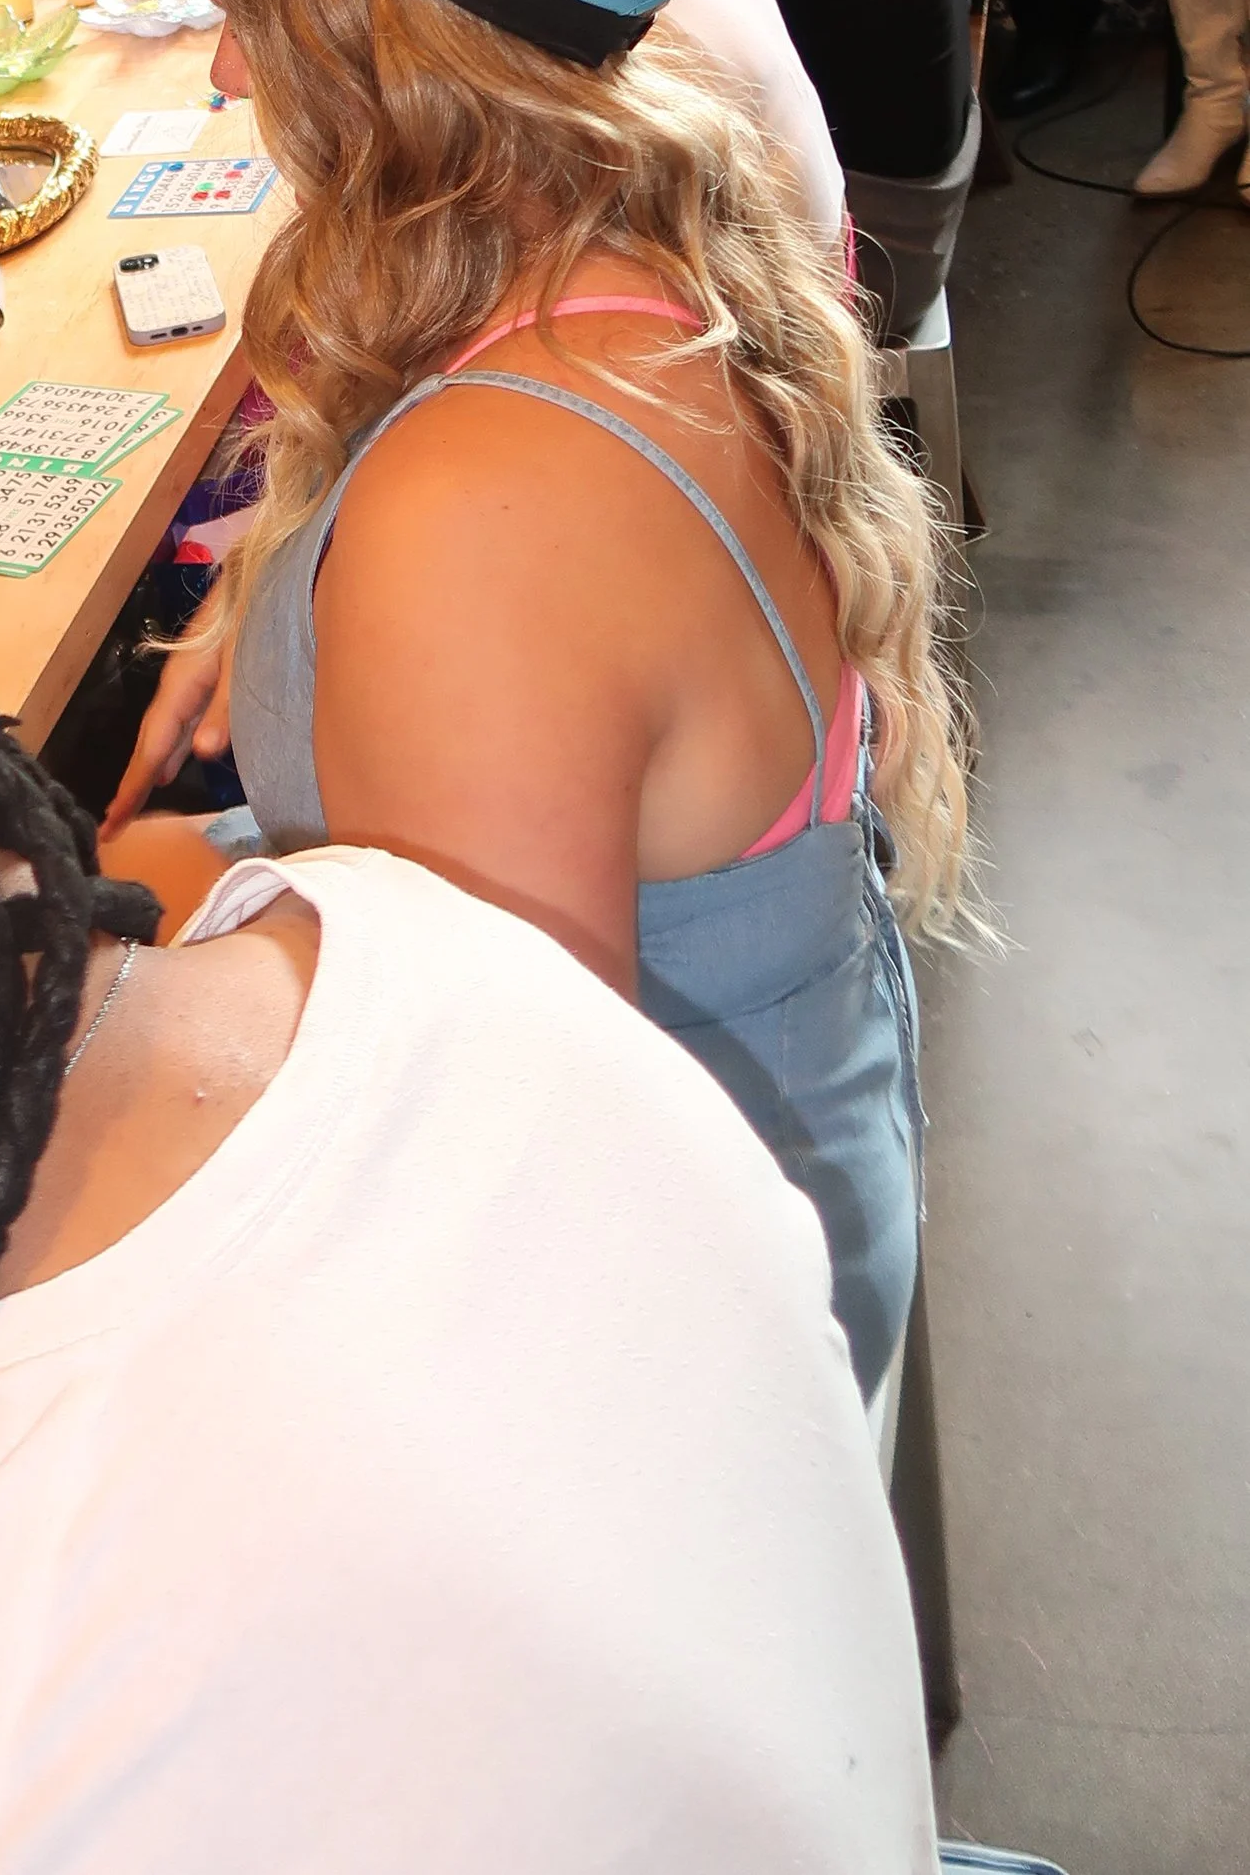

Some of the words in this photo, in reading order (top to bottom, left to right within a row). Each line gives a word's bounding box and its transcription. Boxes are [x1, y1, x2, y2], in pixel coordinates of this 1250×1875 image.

[114, 163, 163, 214] BINGO
[31, 385, 55, 394] 65
[54, 387, 79, 397] 60
[79, 390, 105, 400] 44
[13, 397, 42, 408] 75
[105, 393, 133, 403] 30
[42, 400, 67, 411] 56
[66, 403, 90, 413] 43
[95, 406, 120, 416] 26
[2, 410, 24, 421] 66
[124, 408, 140, 418] 3
[26, 414, 52, 424] 53
[80, 418, 103, 430] 16
[9, 426, 34, 437] 47
[104, 421, 129, 433] 10
[38, 429, 63, 441] 31
[62, 432, 90, 444] 27
[0, 439, 20, 452] 46
[22, 442, 49, 455] 39
[53, 446, 77, 457] 21
[6, 472, 31, 486] 75
[18, 492, 42, 506] 51
[33, 475, 57, 490] 74
[0, 548, 16, 557] 6
[11, 528, 36, 544] 21
[27, 511, 52, 526] 31
[44, 494, 69, 510] 53
[61, 478, 83, 493] 69
[25, 553, 44, 561] 3
[37, 531, 62, 548] 29
[54, 514, 79, 531] 35
[71, 497, 95, 514] 50
[86, 481, 112, 497] 72
